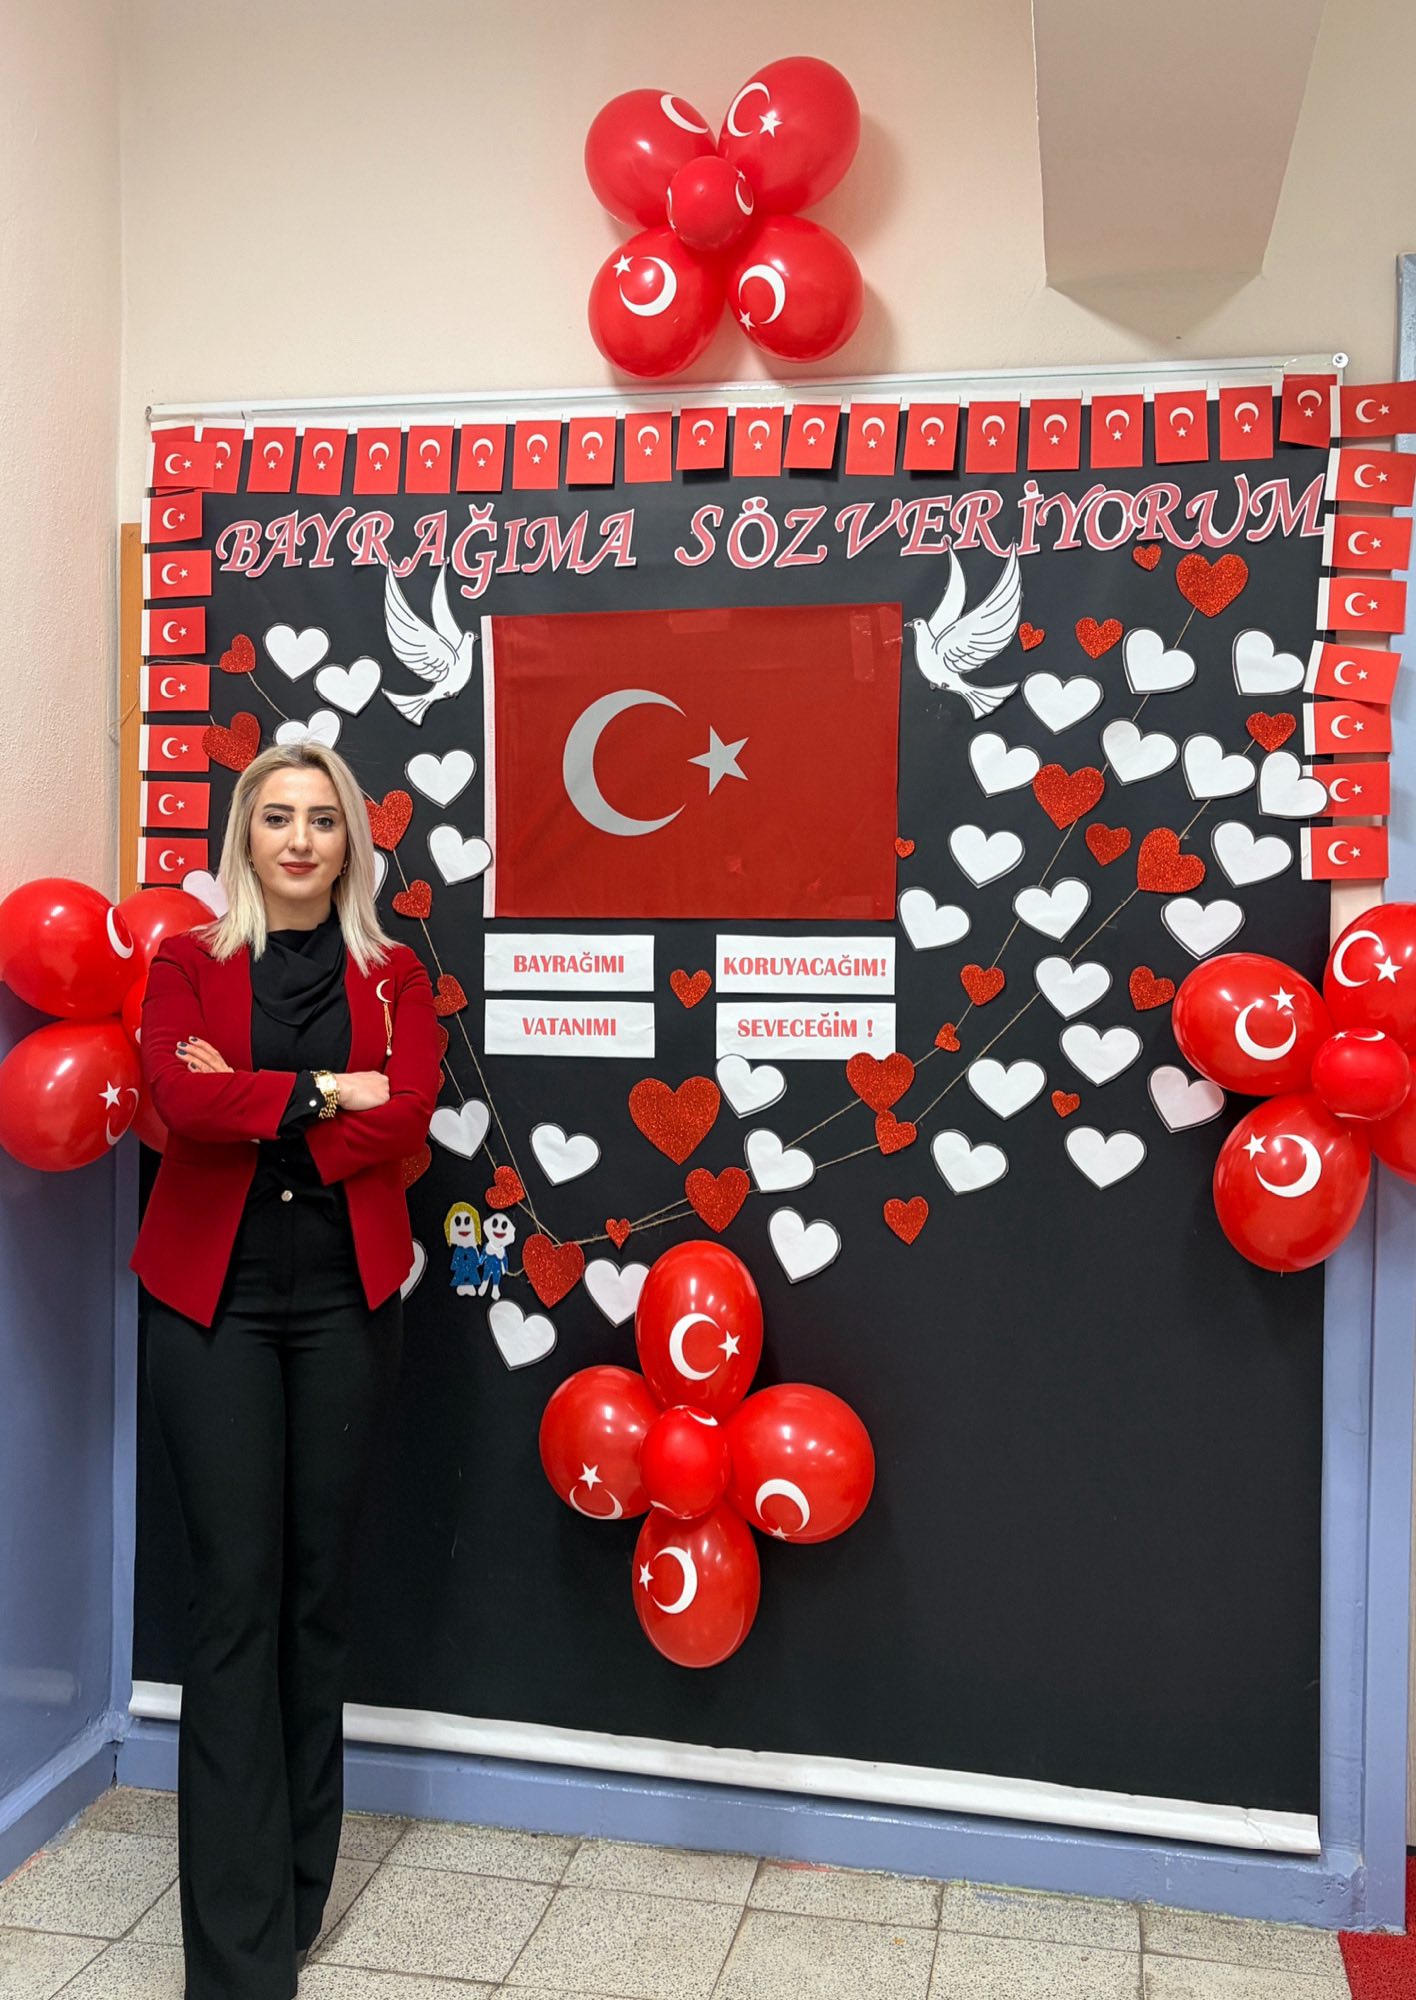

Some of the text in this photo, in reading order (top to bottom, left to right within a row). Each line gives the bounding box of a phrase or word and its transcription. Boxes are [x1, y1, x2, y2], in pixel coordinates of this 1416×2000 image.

[215, 502, 637, 600] BAYRAĞIMA
[513, 951, 625, 974] BAYRAĞIMI
[723, 954, 887, 977] KORUYACAĞIM!
[522, 1017, 617, 1037] VATANIMI
[737, 1011, 858, 1038] SEVECEĞİM
